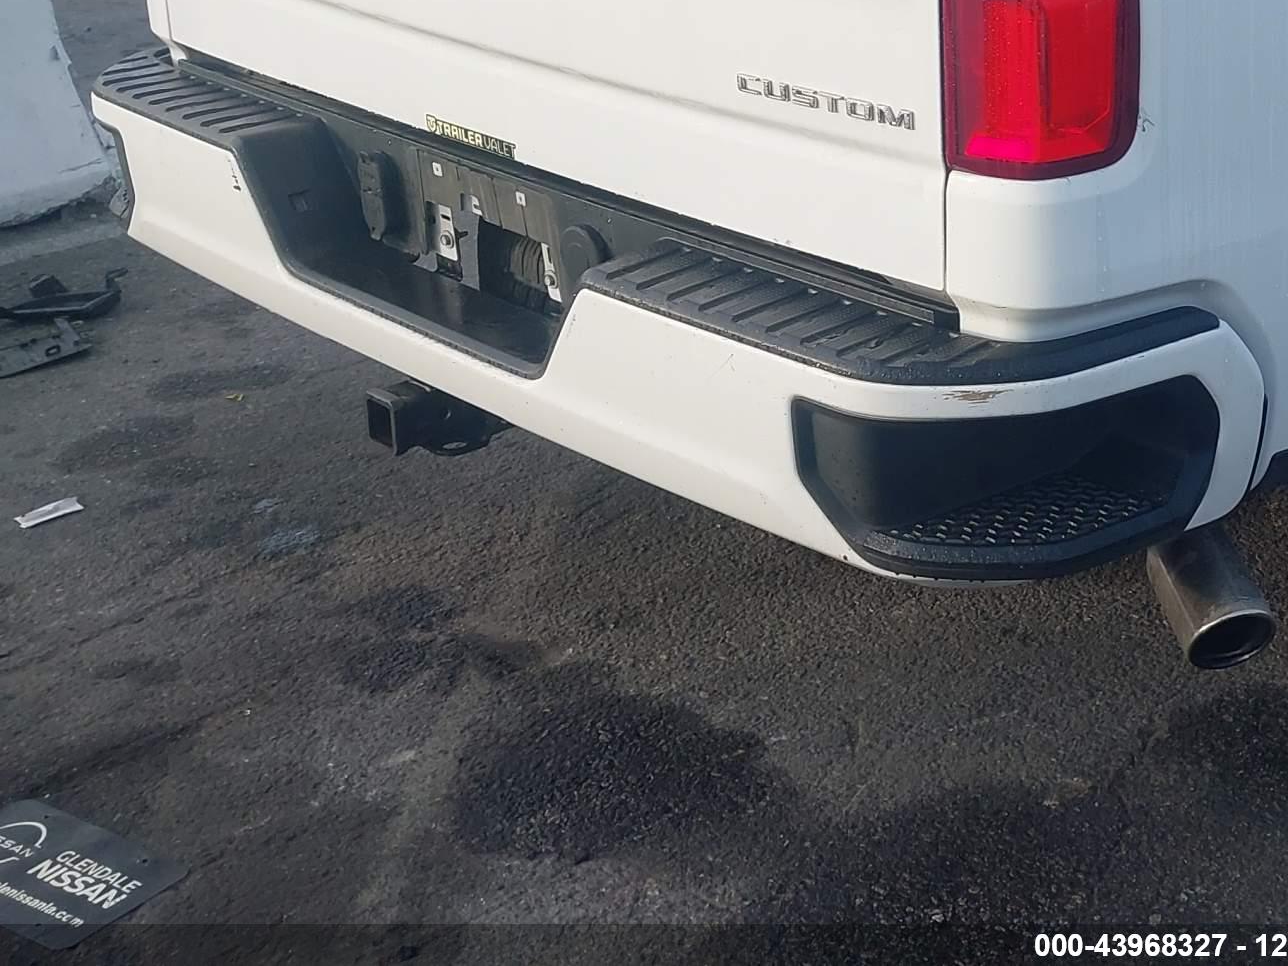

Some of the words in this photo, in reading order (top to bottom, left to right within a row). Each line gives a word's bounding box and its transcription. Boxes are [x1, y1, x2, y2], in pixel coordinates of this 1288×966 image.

[736, 73, 916, 131] CUSTOM
[26, 858, 128, 910] NISSAN
[55, 850, 143, 894] GLENDALE
